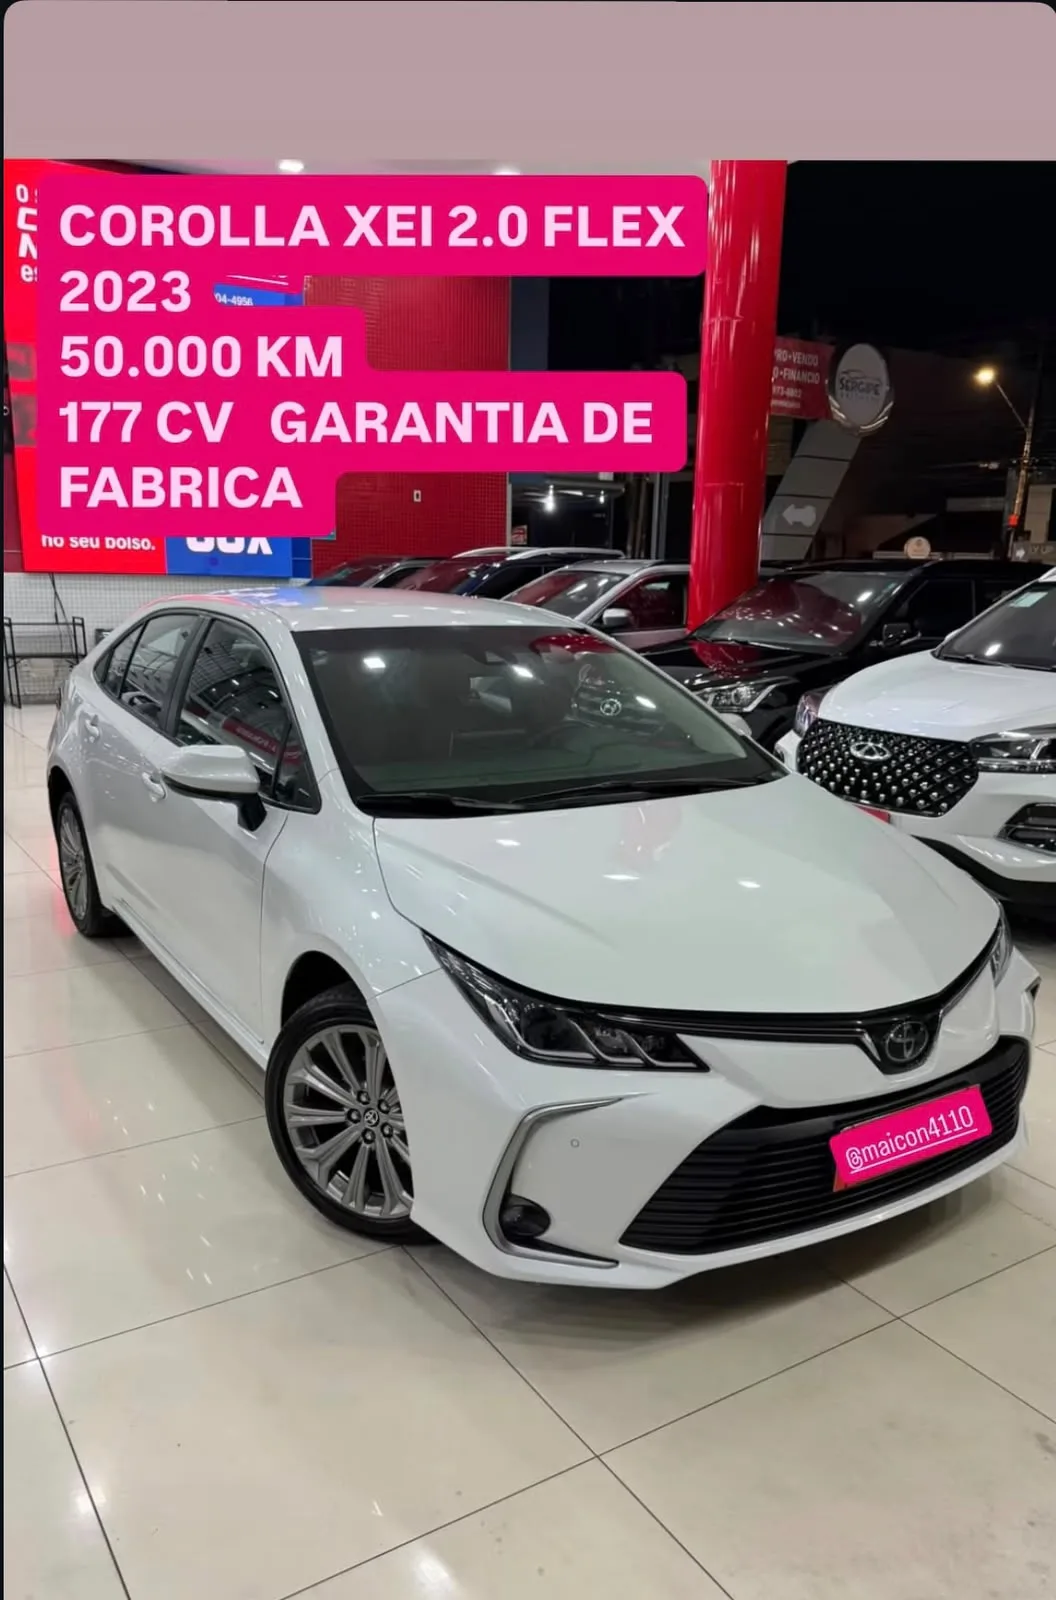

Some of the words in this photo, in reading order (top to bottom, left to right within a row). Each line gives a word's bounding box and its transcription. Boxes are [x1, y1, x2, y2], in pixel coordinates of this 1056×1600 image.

[41, 534, 65, 548] no
[69, 536, 100, 549] seu
[104, 536, 156, 550] bolso.
